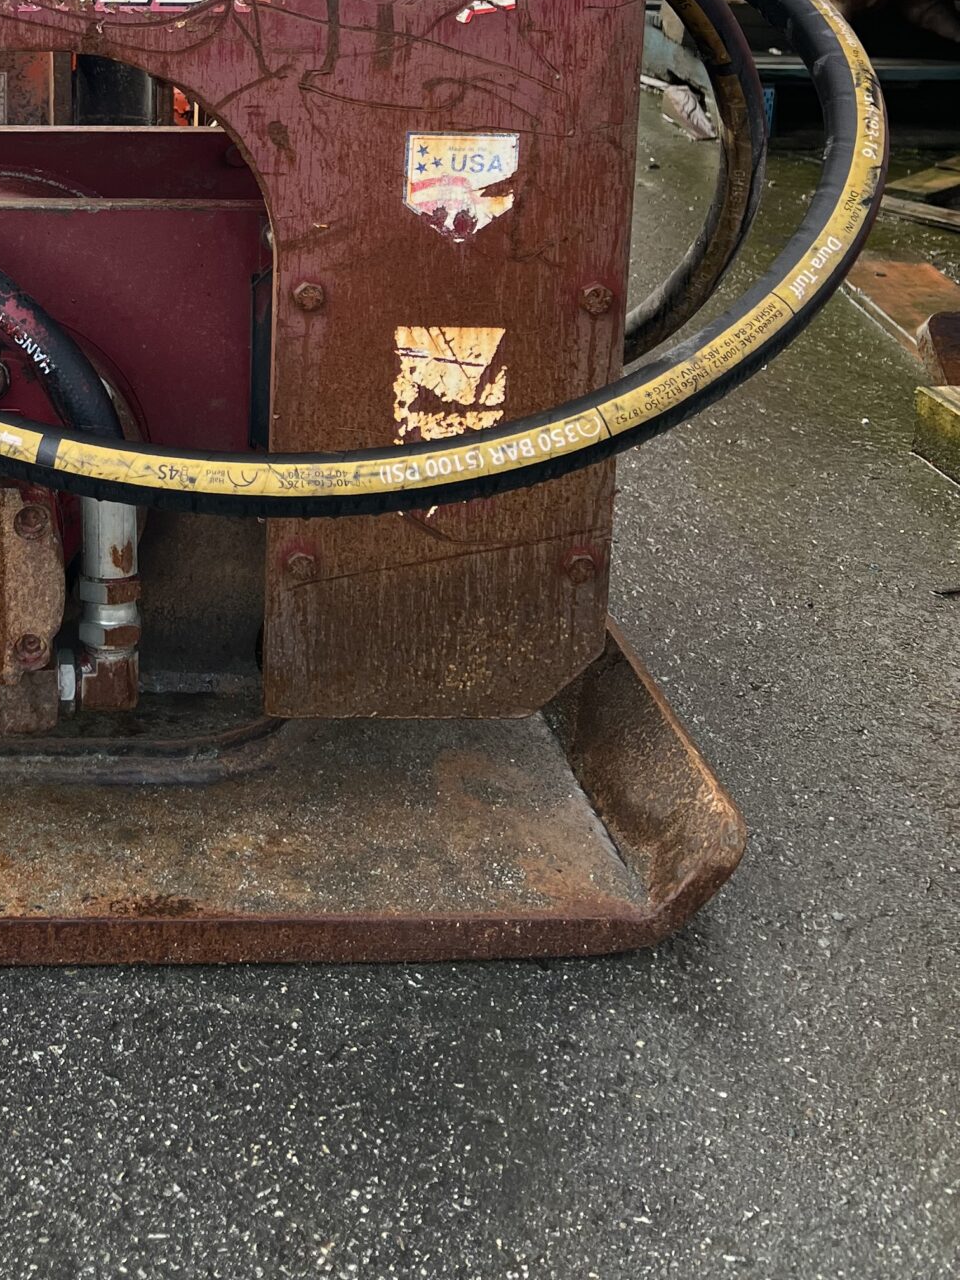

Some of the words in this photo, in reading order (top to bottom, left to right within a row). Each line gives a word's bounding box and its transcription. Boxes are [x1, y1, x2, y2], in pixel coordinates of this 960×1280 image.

[451, 153, 503, 173] USA
[843, 190, 859, 213] DN25
[788, 235, 842, 300] Dura-Tuff
[754, 303, 777, 327] MSHA
[754, 309, 784, 336] Exceeds
[740, 333, 758, 349] SAE
[652, 376, 679, 396] USCG
[615, 407, 644, 426] 18752
[644, 398, 662, 413] ISO
[537, 422, 580, 453] 350
[425, 447, 485, 477] (5100
[490, 437, 536, 466] BAR
[380, 461, 420, 484] PSI)
